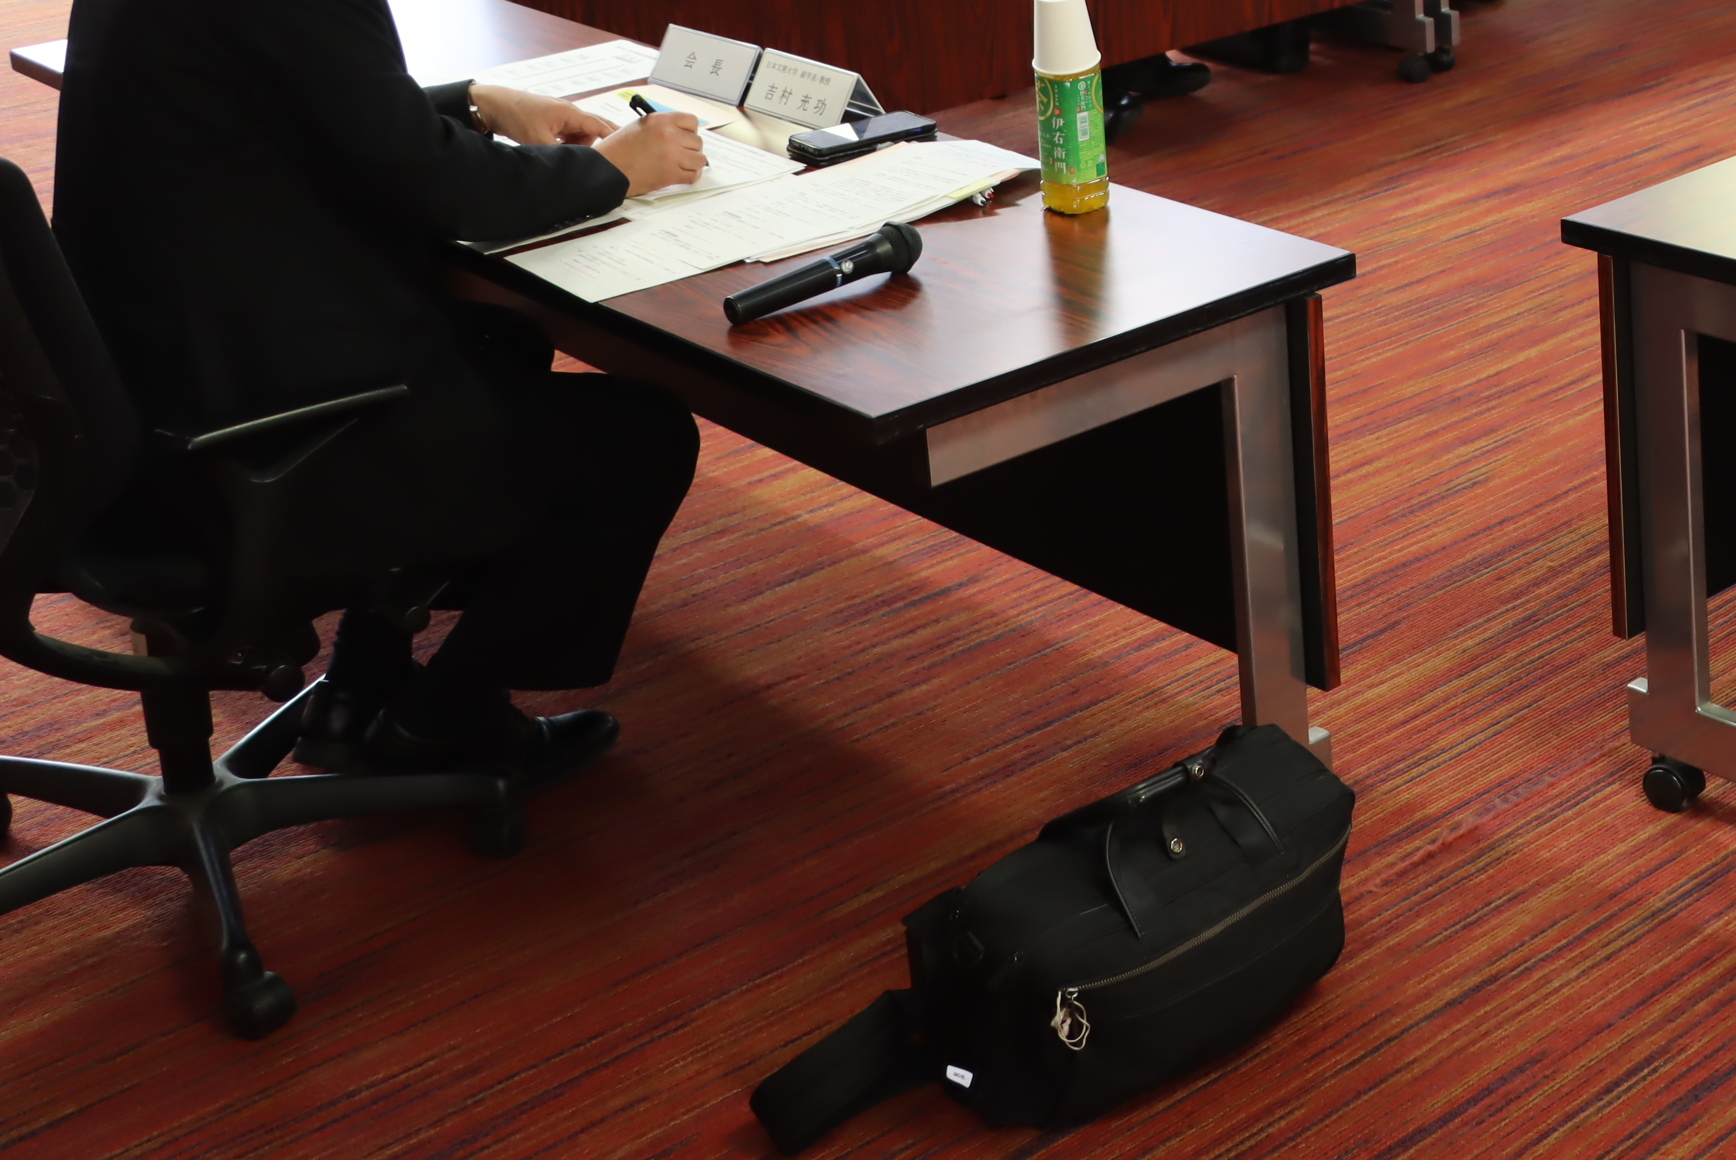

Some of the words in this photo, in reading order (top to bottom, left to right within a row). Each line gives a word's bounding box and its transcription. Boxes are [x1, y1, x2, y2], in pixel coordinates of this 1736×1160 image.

[764, 83, 793, 105] 吉村
[797, 93, 827, 116] 充功
[1052, 117, 1066, 174] 伊右衛門
